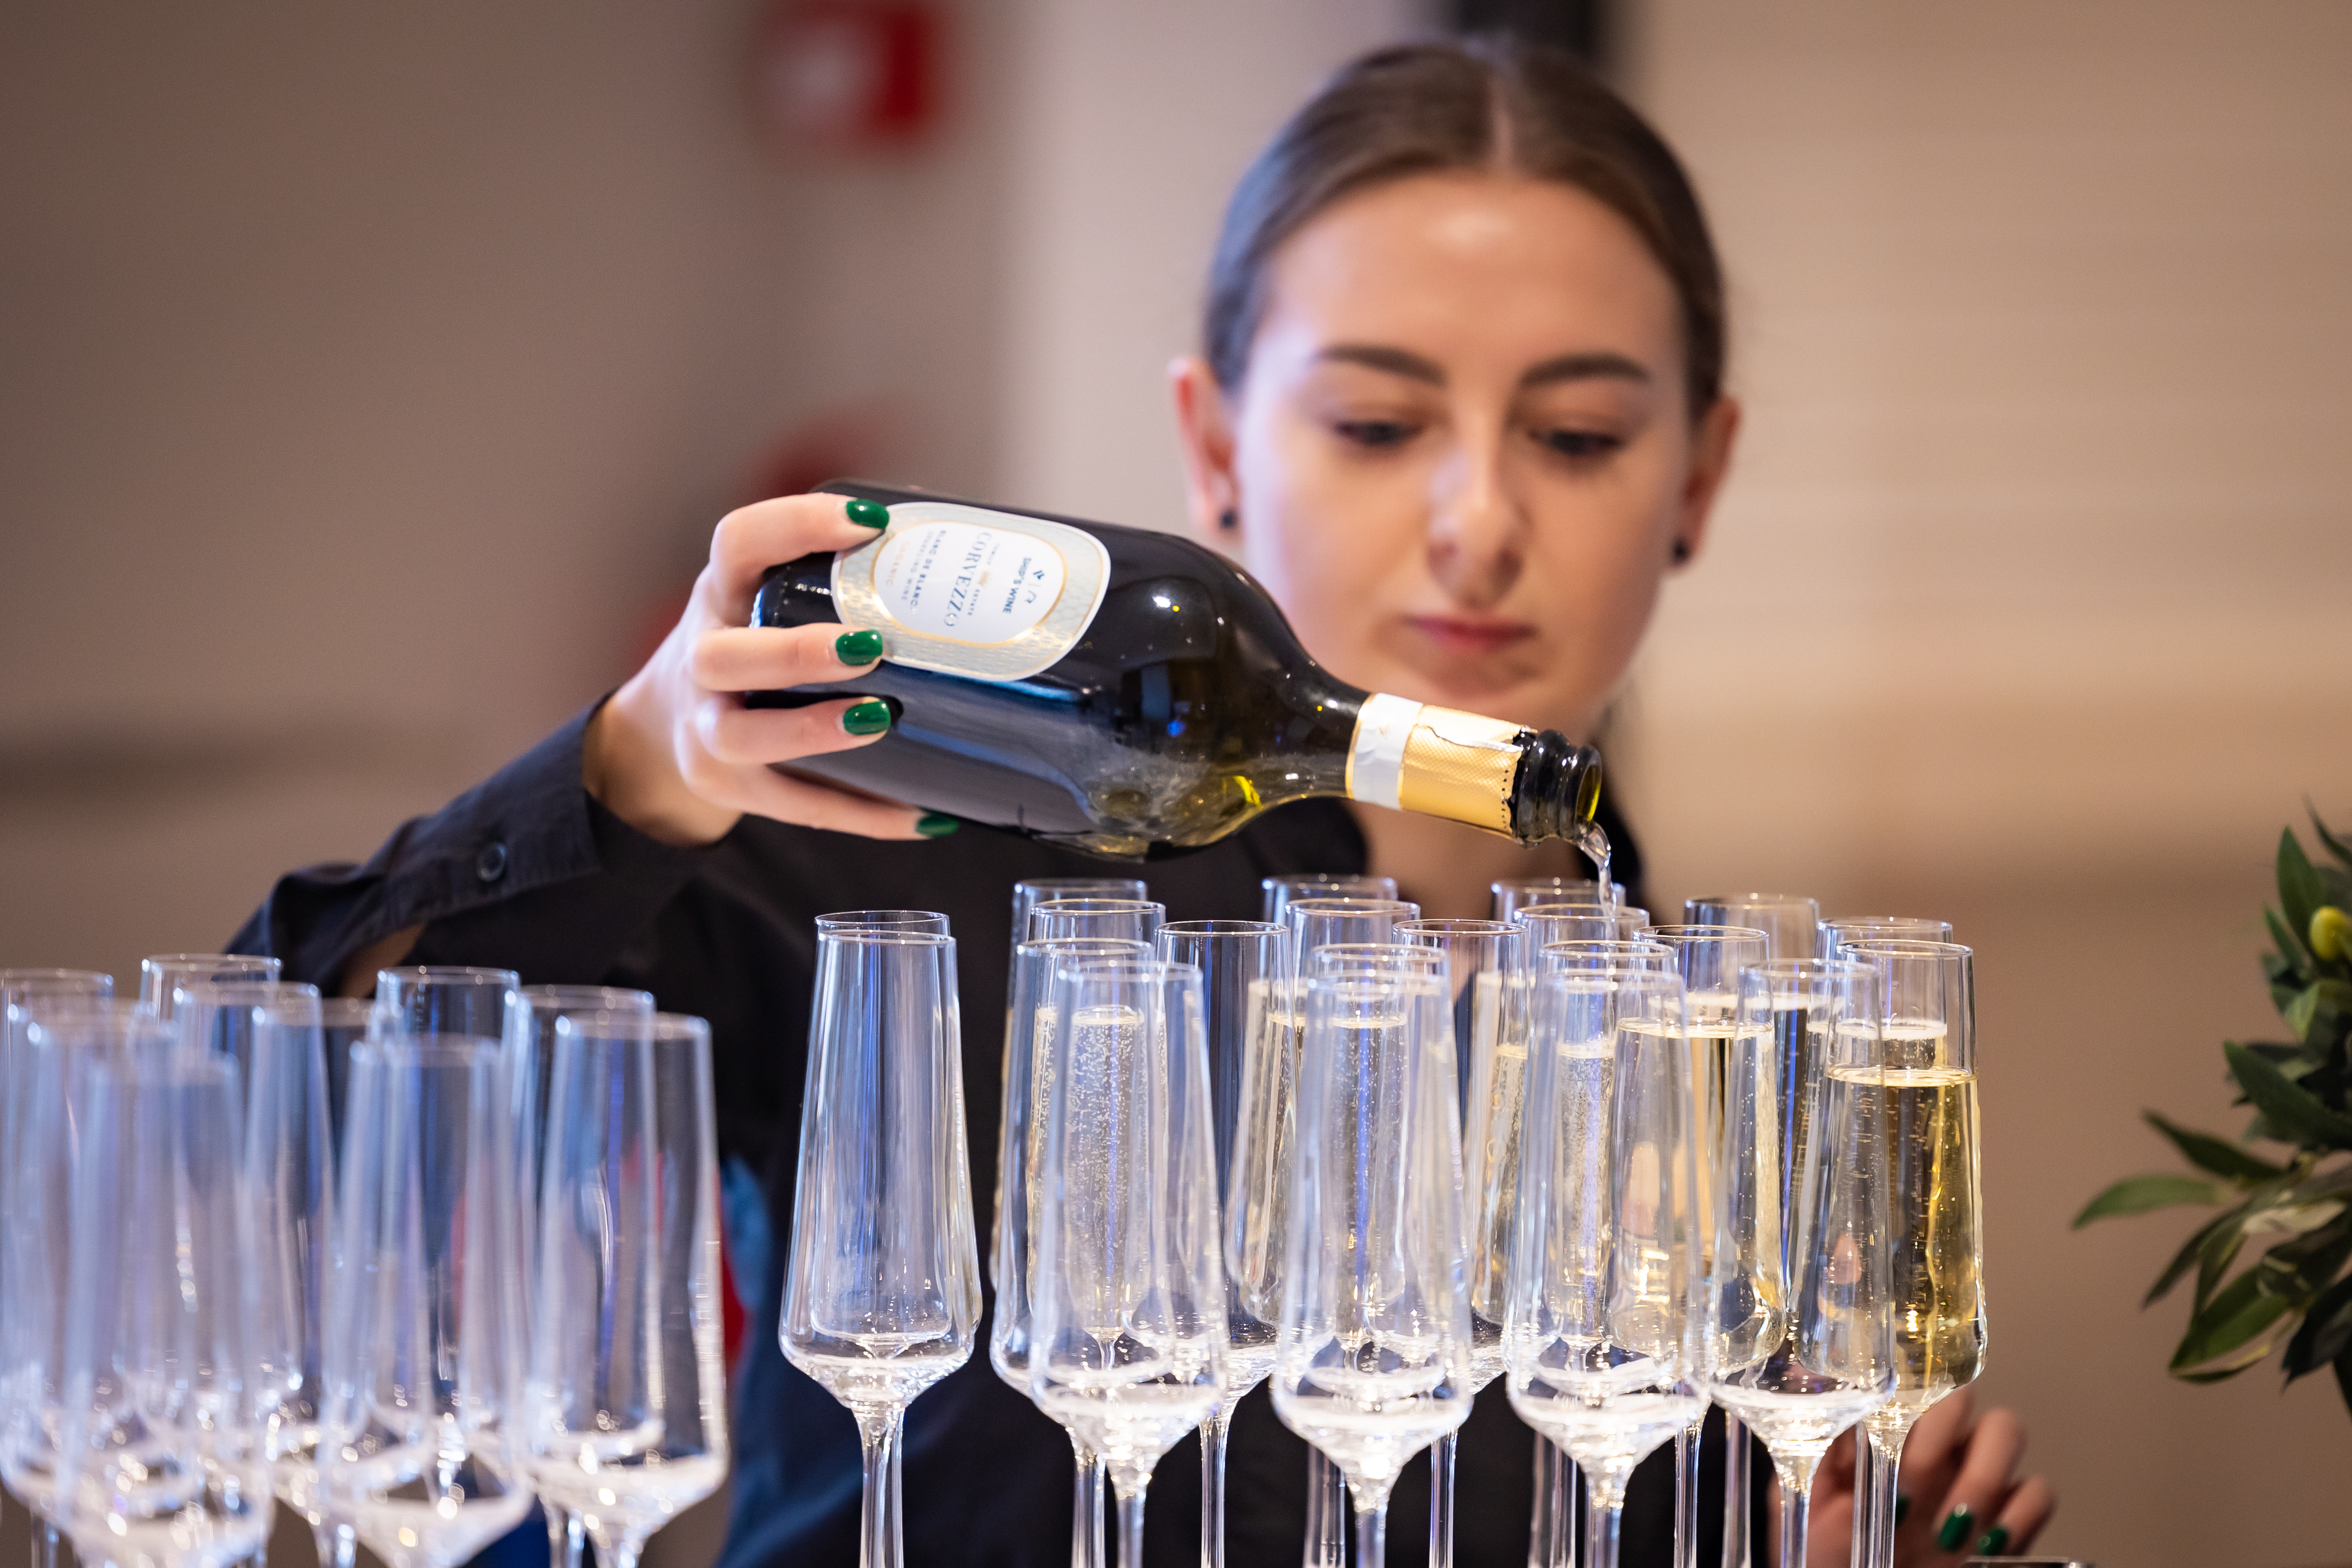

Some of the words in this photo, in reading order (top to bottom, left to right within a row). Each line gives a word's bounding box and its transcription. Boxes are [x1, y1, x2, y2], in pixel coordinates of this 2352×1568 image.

[928, 531, 946, 555] BLANC
[923, 558, 932, 569] DE
[1013, 557, 1031, 585] SHIP'S
[901, 578, 913, 600] WINE
[944, 532, 992, 627] CORVEZZO
[968, 589, 980, 616] ESTATE
[1003, 587, 1018, 613] WINE
